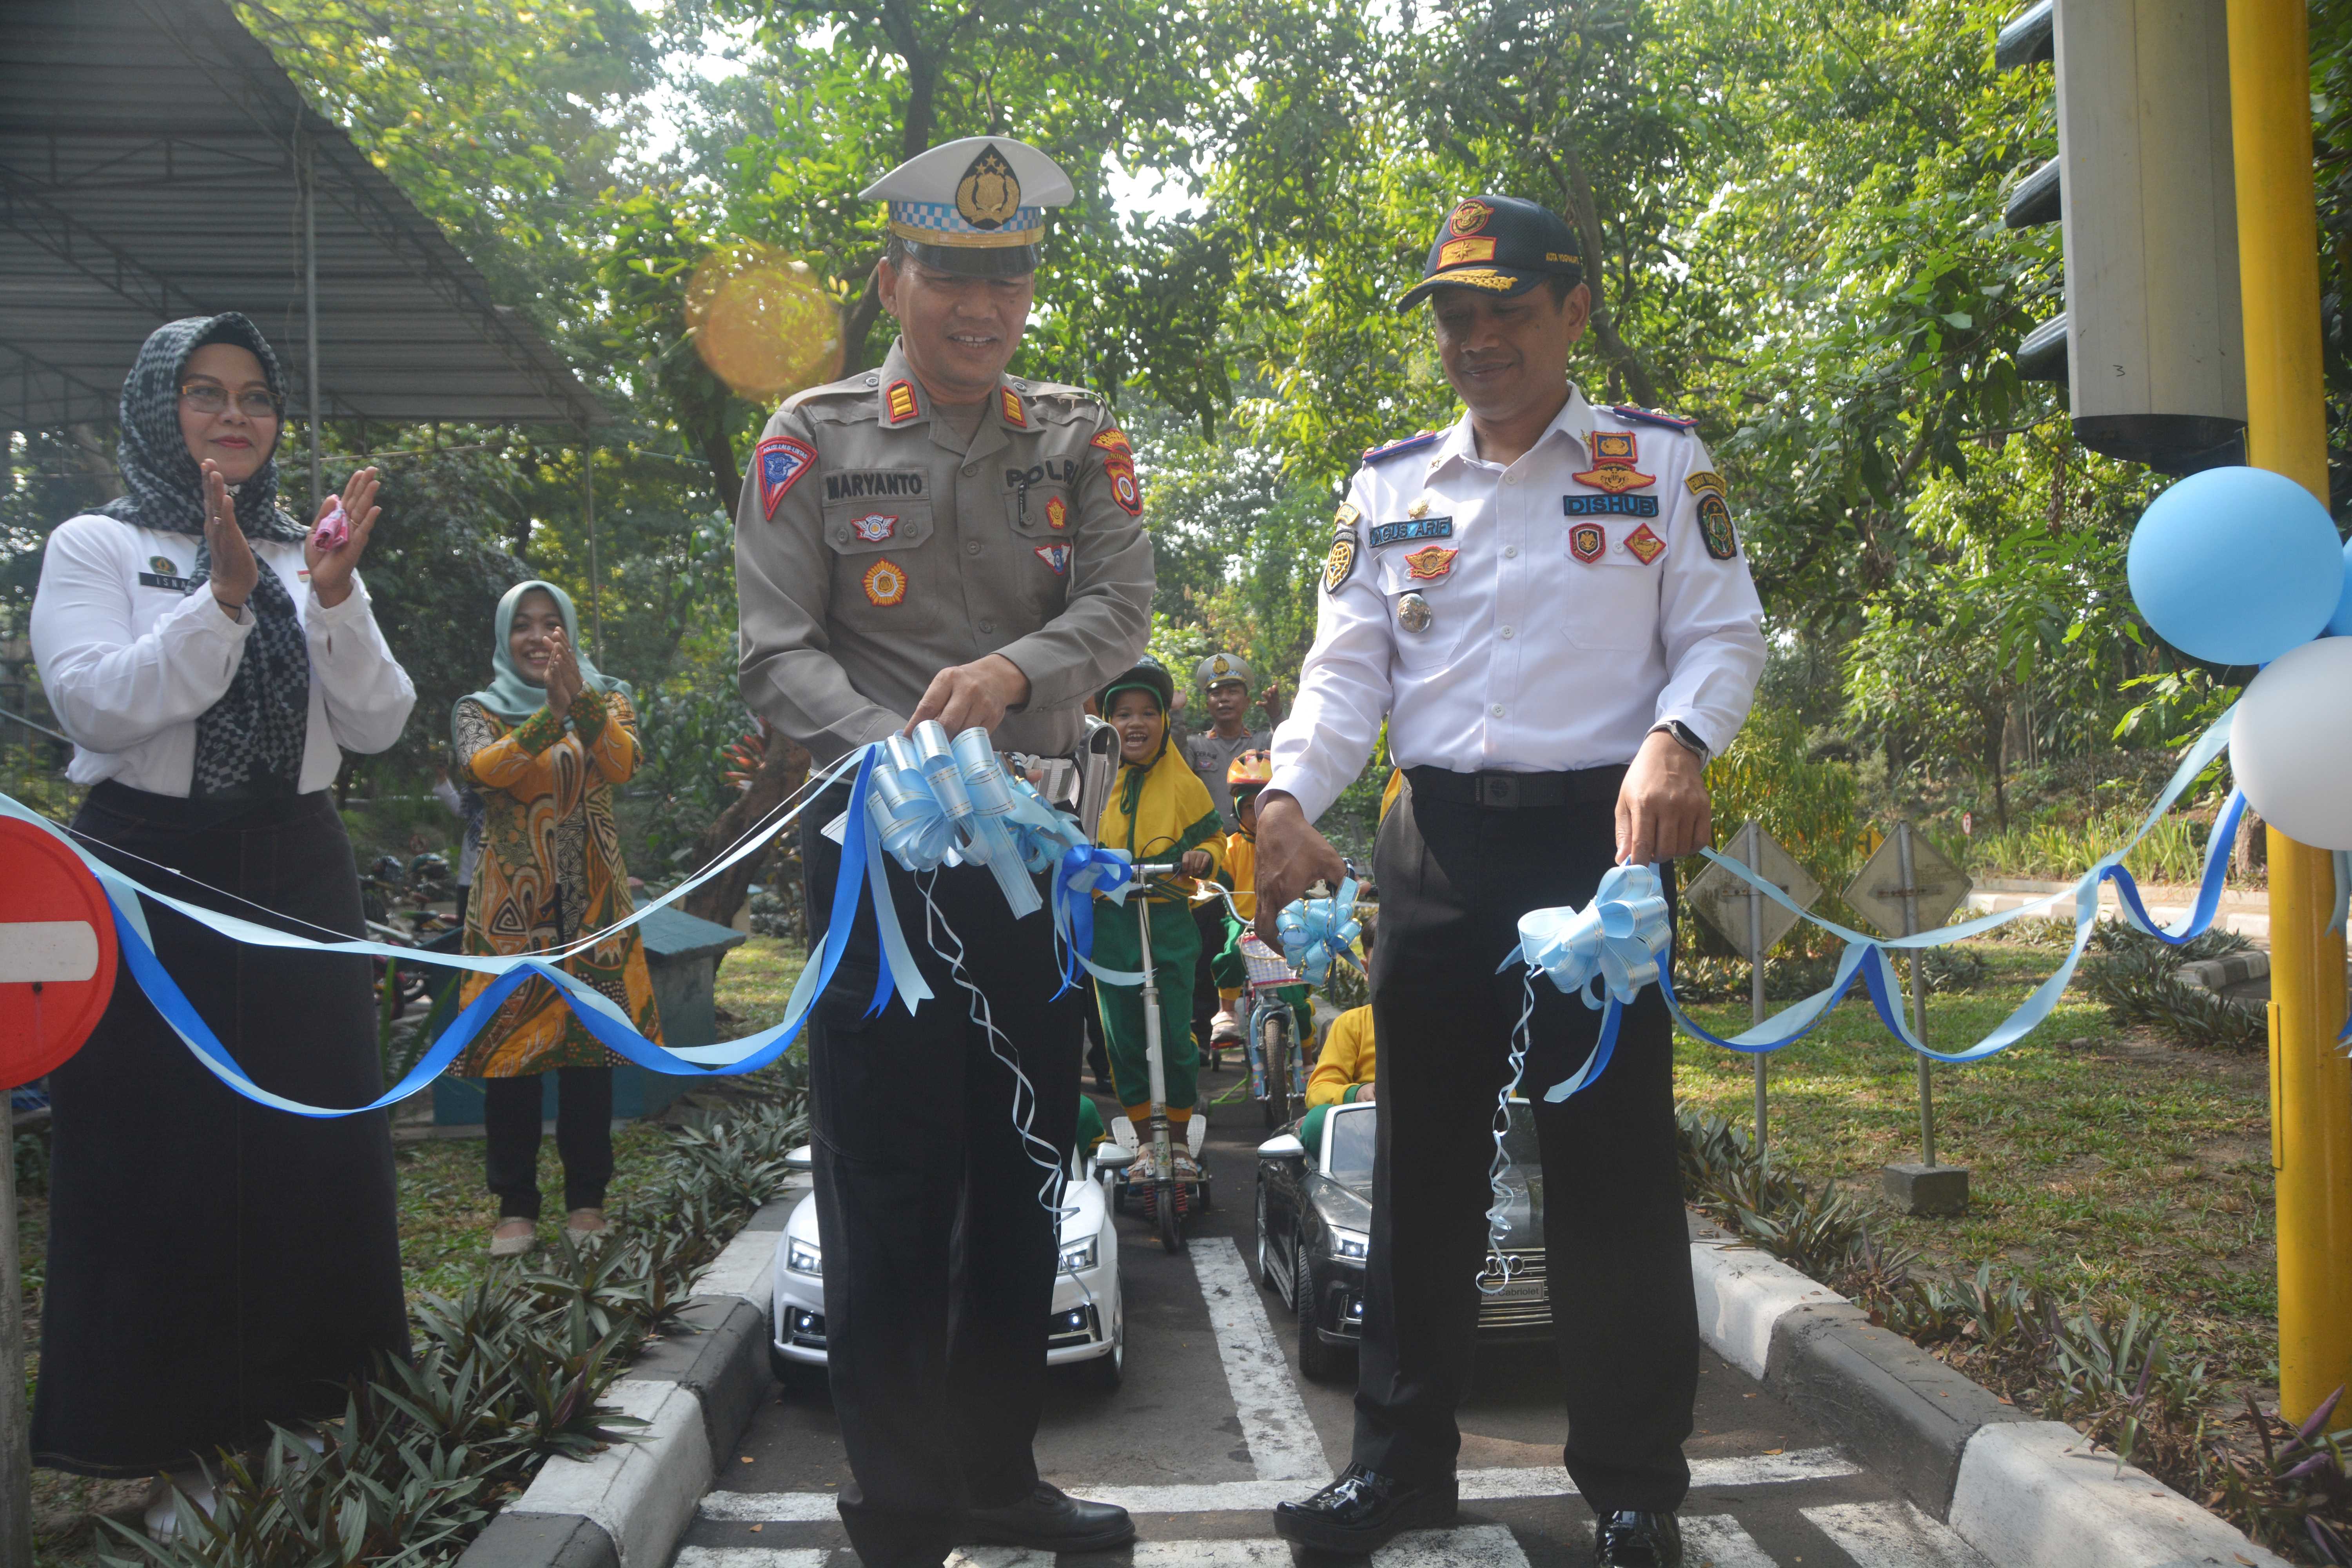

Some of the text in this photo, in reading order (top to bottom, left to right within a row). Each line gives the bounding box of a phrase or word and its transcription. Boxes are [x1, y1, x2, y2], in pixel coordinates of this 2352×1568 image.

[2112, 365, 2125, 377] 3
[763, 444, 777, 453] POLISI
[826, 472, 922, 500] MARYANTO
[1569, 496, 1653, 514] DISHUB
[1373, 524, 1408, 544] AGUS
[1416, 520, 1447, 537] ARIF
[1498, 1287, 1539, 1296] Cabriolet
